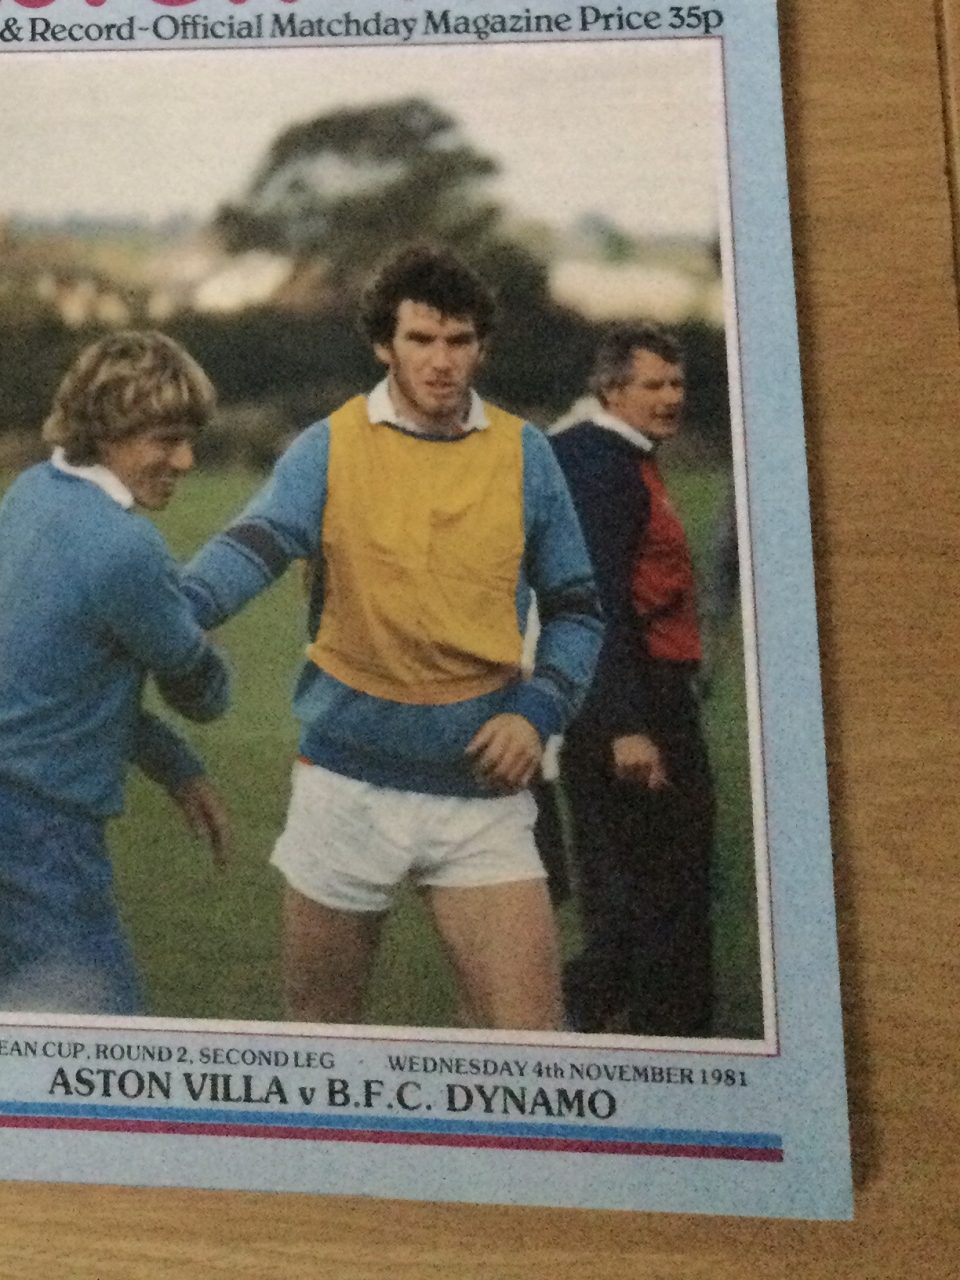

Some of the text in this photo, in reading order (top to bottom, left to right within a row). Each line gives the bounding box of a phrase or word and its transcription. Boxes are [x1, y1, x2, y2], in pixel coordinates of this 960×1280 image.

[0, 16, 23, 42] &
[270, 11, 417, 41] Matchday
[424, 9, 572, 40] Magazine
[580, 5, 662, 32] Price
[668, 6, 724, 35] 35p
[95, 1043, 172, 1064] ROUND
[199, 1047, 290, 1069] SECOND
[293, 1051, 336, 1070] LEG
[387, 1054, 529, 1079] WEDNESDAY
[531, 1060, 565, 1080] 4th
[569, 1063, 694, 1086] NOVEMBER
[699, 1068, 749, 1088] 1981
[48, 1066, 617, 1120] ASTON VILLA v B.F.C. DYNAMO
